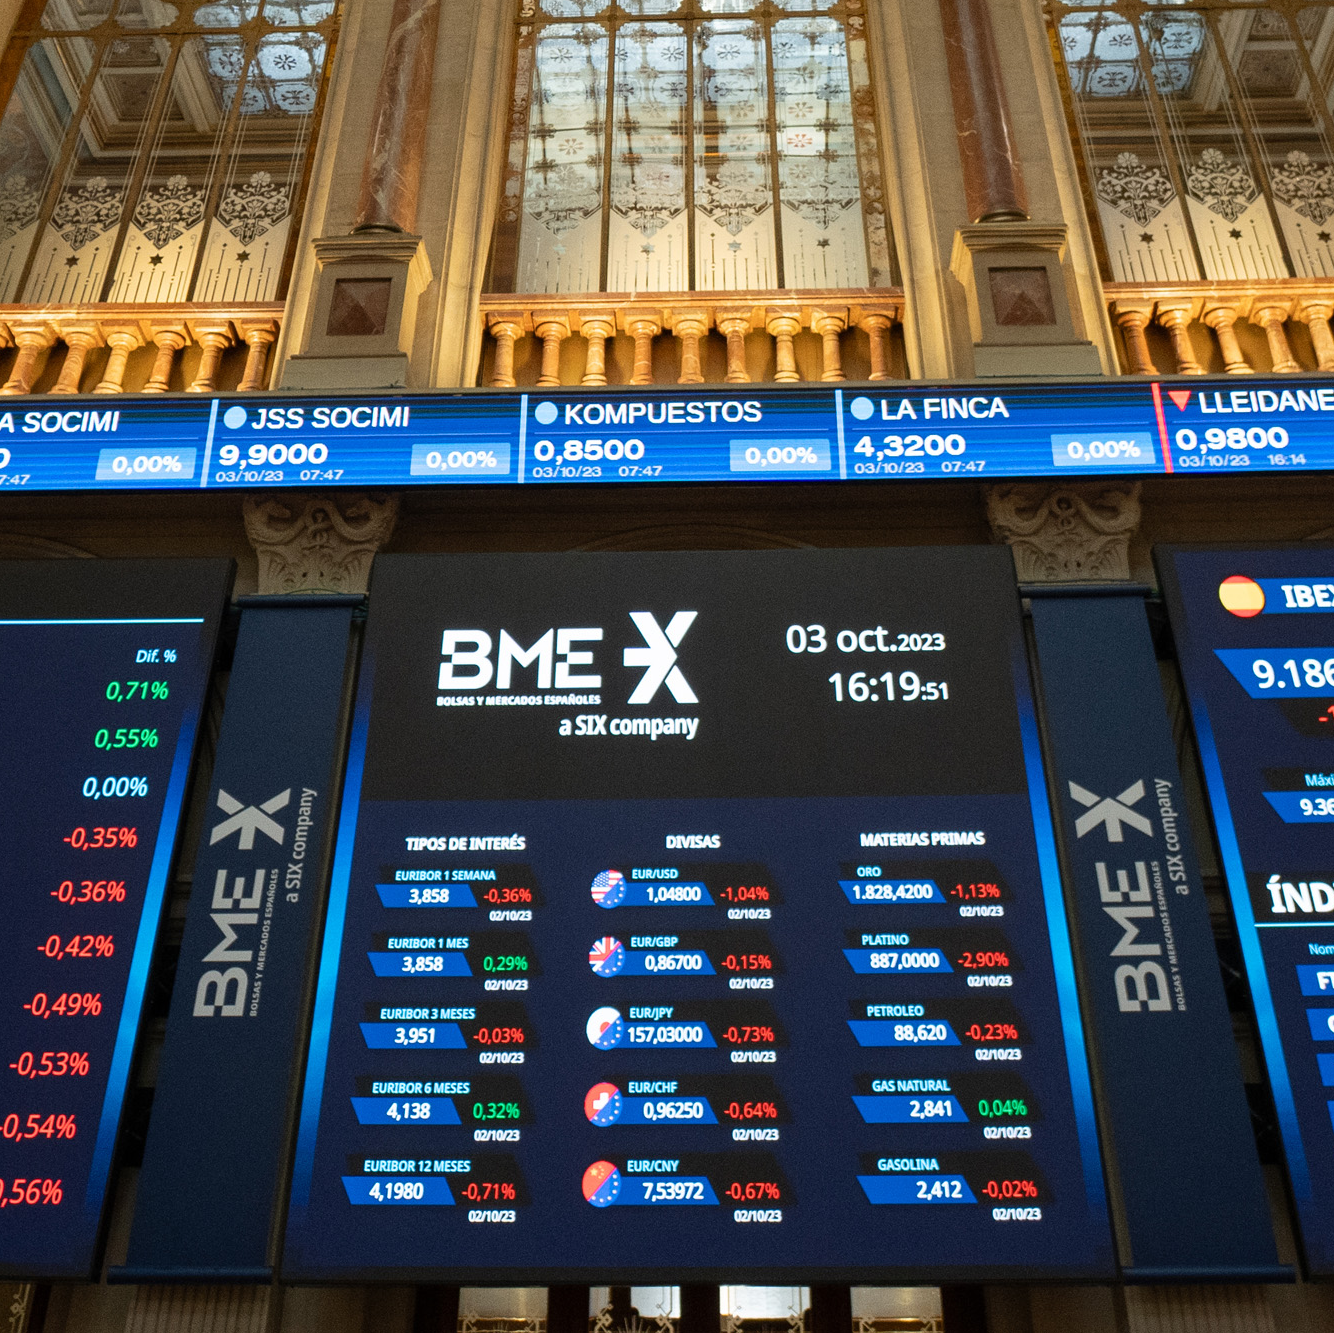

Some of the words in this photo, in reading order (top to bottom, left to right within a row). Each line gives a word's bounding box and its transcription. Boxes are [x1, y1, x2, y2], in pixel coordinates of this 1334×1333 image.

[252, 408, 305, 429] JSS
[311, 406, 409, 428] SOCIMI
[564, 402, 762, 425] KOMPUESTOS
[881, 399, 916, 420] LA
[924, 397, 1010, 419] FINCA
[22, 411, 120, 432] SOCIMI
[854, 434, 965, 460] 4,3200
[1067, 441, 1140, 459] 0,00%
[1175, 427, 1289, 454] 0,9800
[219, 443, 329, 468] 9,9000
[534, 439, 645, 464] 0,8500
[112, 456, 182, 473] 0,00%
[785, 624, 827, 654] 03
[135, 649, 161, 663] Dif.
[163, 650, 177, 663] %
[437, 627, 603, 690] BME
[106, 681, 169, 701] 0,71%
[828, 671, 949, 703] 16:19:51
[436, 696, 475, 706] BOLSAS
[486, 695, 542, 706] MERCADOS
[544, 693, 601, 705] ESPAÑOLES
[559, 720, 571, 736] a
[575, 716, 607, 735] SIX
[610, 716, 699, 741] company
[82, 776, 148, 799] 0,00%
[63, 826, 138, 850] -0,35%
[405, 837, 446, 851] TIPOS
[449, 838, 467, 850] DE
[469, 833, 526, 850] INTERÉS
[666, 835, 721, 849] DIVISAS
[860, 833, 929, 847] MATERIAS
[931, 832, 986, 845] PRIMAS
[395, 871, 441, 881] EURIBOR
[444, 871, 449, 881] 1
[451, 870, 496, 881] SEMANA
[632, 868, 678, 880] EUR/USD
[856, 867, 881, 877] ORO
[409, 888, 449, 904] 3,858
[483, 889, 532, 904] -0,36%
[646, 886, 701, 902] 1,04800
[853, 884, 933, 901] 1.828,4200
[489, 911, 532, 921] 02/10/23
[192, 869, 266, 1017] BME
[249, 984, 262, 1017] BOLSAS
[257, 920, 271, 971] MERCADOS
[265, 868, 279, 917] ESPAÑOLES
[630, 936, 678, 948] EUR/GBP
[862, 934, 909, 946] PLATINO
[1094, 861, 1173, 1012] BME
[37, 935, 115, 959] -0,42%
[645, 955, 702, 971] 0,86700
[629, 1007, 673, 1019] EUR/JPY
[867, 1005, 924, 1017] PETROLEO
[627, 1026, 703, 1045] 157,03000
[9, 1052, 90, 1078] -0,53%
[628, 1082, 678, 1094] EUR/CHF
[872, 1081, 896, 1092] GAS
[897, 1080, 951, 1092] NATURAL
[627, 1160, 679, 1173] EUR/CNY
[878, 1159, 939, 1171] GASOLINA
